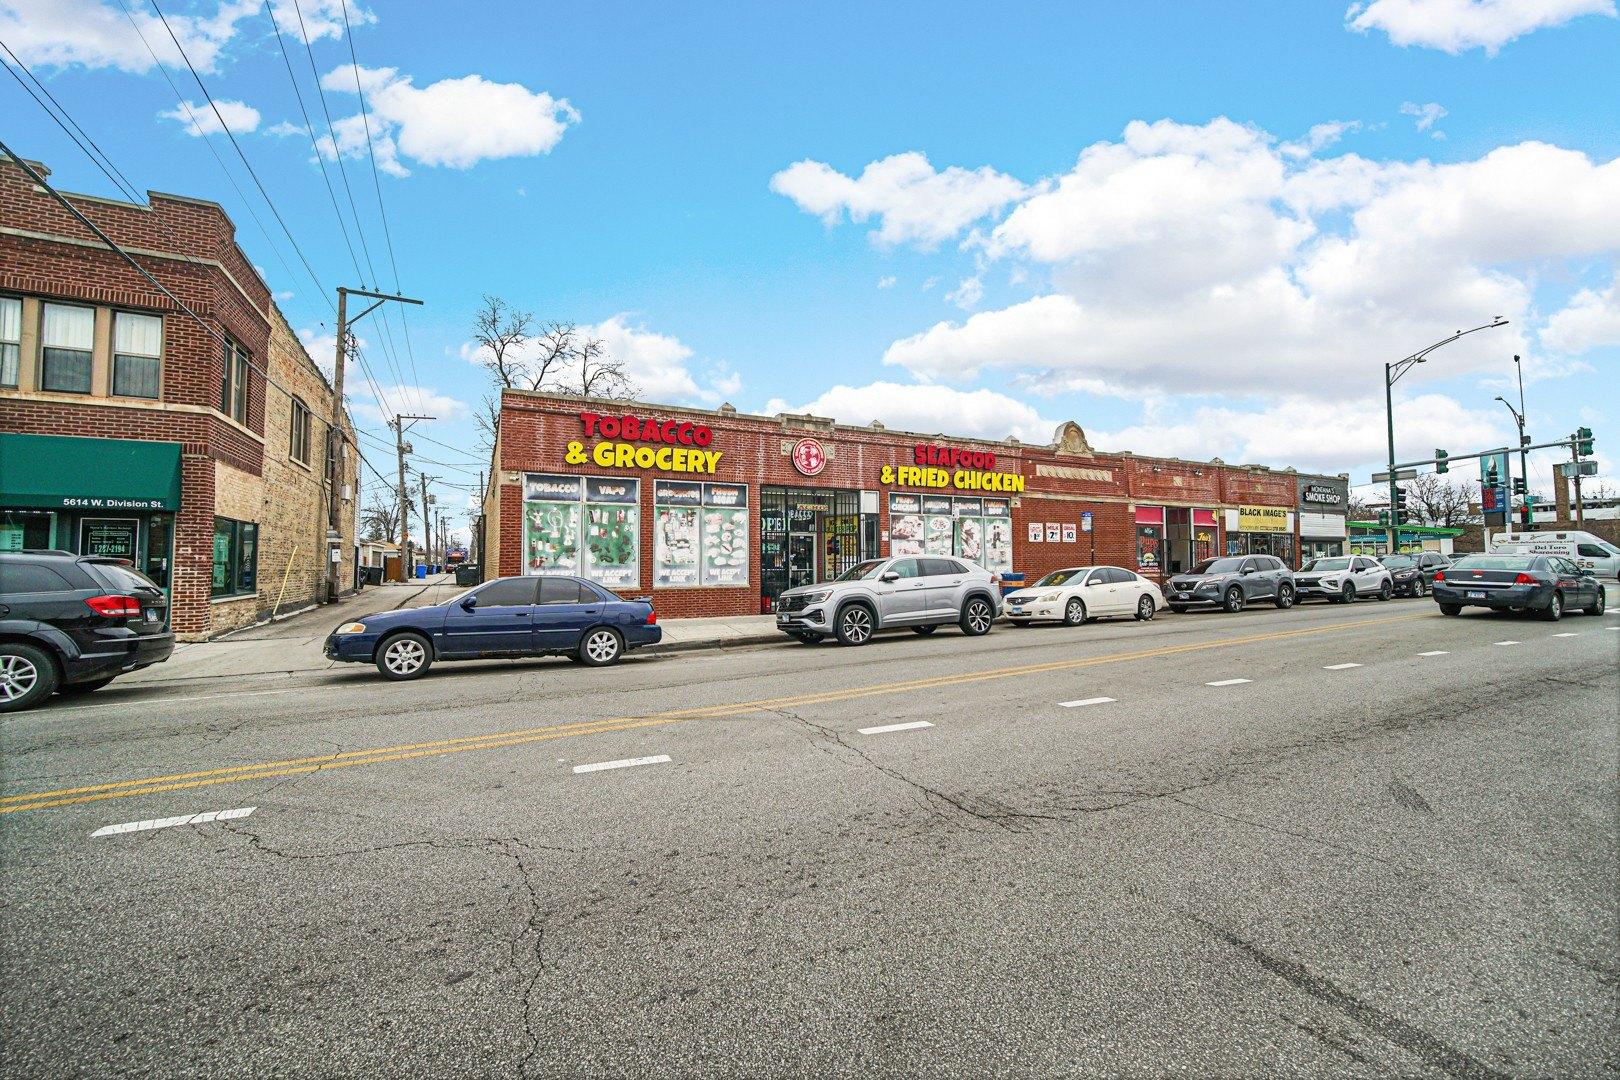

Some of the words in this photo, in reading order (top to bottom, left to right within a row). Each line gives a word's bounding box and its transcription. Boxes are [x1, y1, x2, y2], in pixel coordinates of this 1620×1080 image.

[580, 412, 713, 447] TOBACCO
[565, 441, 589, 465] &
[593, 441, 723, 474] GROCERY
[914, 443, 996, 470] SEAFOOD
[529, 482, 578, 493] TOBACCO
[880, 464, 895, 484] &
[897, 465, 950, 488] FRIED
[953, 470, 1025, 492] CHICKEN
[63, 498, 88, 506] 5614
[91, 499, 104, 507] W.
[107, 499, 148, 508] Division
[150, 500, 164, 508] St.
[1305, 492, 1325, 502] SMOKE
[1326, 494, 1340, 504] SHOP
[1240, 508, 1262, 516] BLACK
